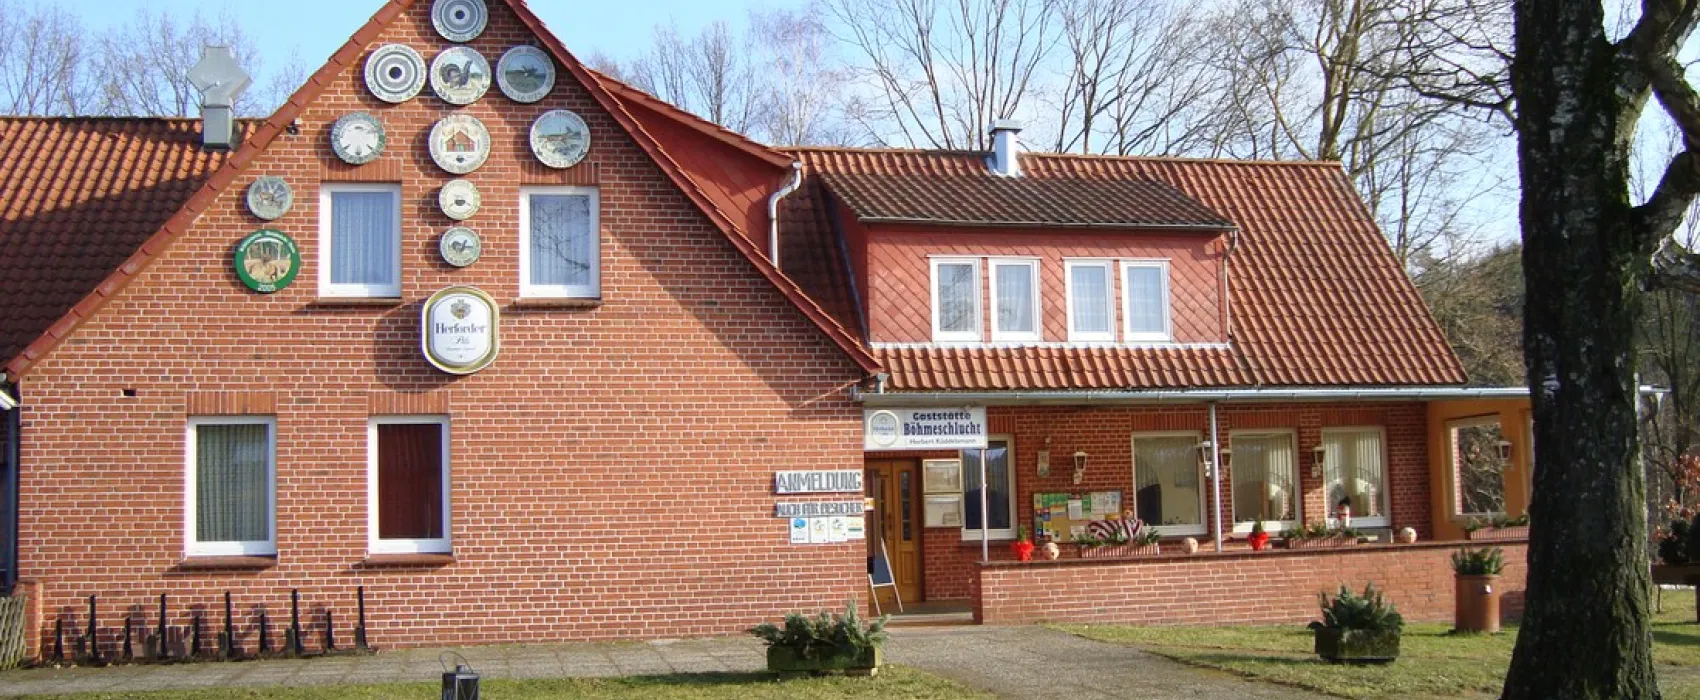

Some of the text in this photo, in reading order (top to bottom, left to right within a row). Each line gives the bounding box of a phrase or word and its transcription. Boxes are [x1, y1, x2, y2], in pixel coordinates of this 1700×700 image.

[435, 322, 486, 334] Herforder
[912, 411, 972, 421] Gaststätte
[903, 421, 981, 436] Böhmeschlucht
[778, 471, 862, 491] ANMELDUNG
[777, 502, 863, 516] AUCH FÜR BESUCHER
